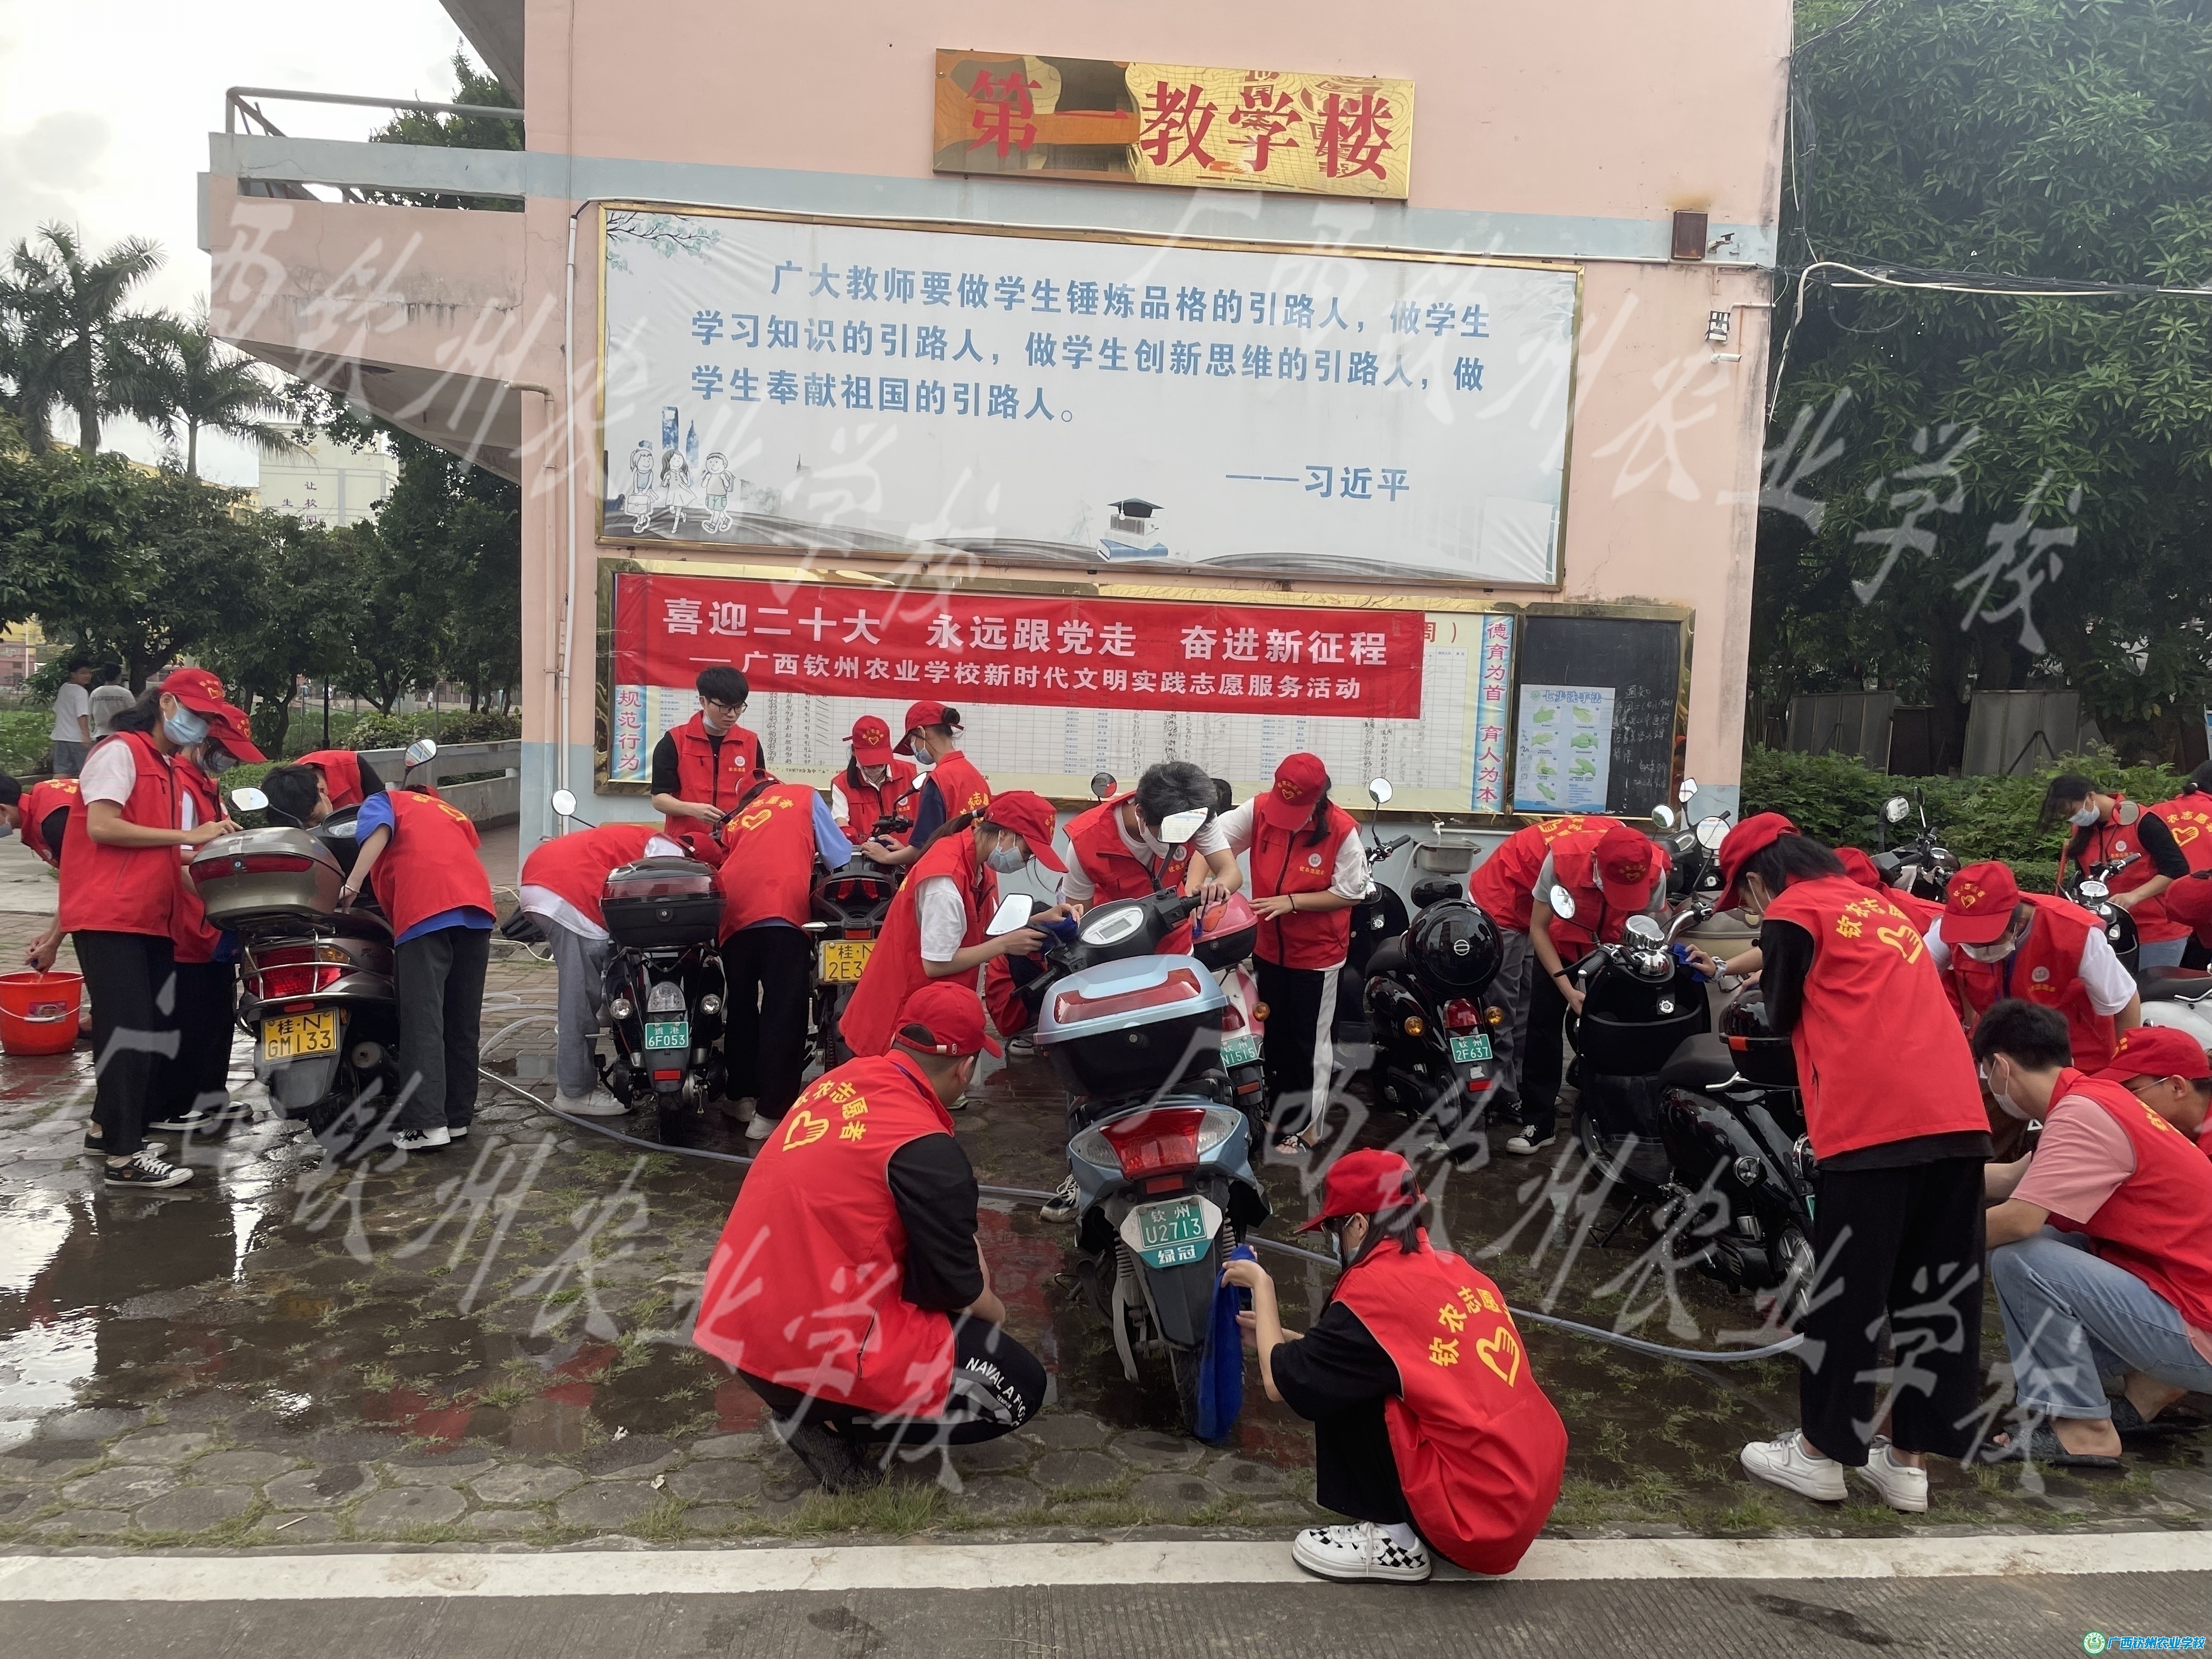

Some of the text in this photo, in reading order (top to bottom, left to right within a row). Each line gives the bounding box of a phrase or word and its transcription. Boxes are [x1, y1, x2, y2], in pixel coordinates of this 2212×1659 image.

[966, 70, 1393, 180] 第一教学楼
[691, 365, 1073, 422] 学生奉献祖国的引路人。
[282, 499, 293, 507] 生
[663, 596, 1387, 667] 喜迎二十大 永远跟党走 奋进新征程
[1483, 623, 1510, 701] 德育为首
[1542, 690, 1602, 704] 七步洗手法
[617, 689, 642, 771] 规范行为
[1476, 725, 1504, 803] 育人为本
[829, 961, 863, 979] 2E3
[277, 1014, 321, 1036] 桂·N
[268, 1030, 331, 1058] GM133
[648, 1035, 685, 1047] 6F053
[1223, 1041, 1248, 1053] 钦州
[1459, 1038, 1482, 1048] 钦州
[1221, 1047, 1255, 1065] N1515
[1456, 1047, 1488, 1060] 2F637
[1151, 1204, 1190, 1223] 钦州
[1145, 1218, 1201, 1244] U2713
[1158, 1245, 1197, 1265] 绿冠
[965, 1357, 1005, 1391] NAVAL
[1002, 1385, 1014, 1400] A
